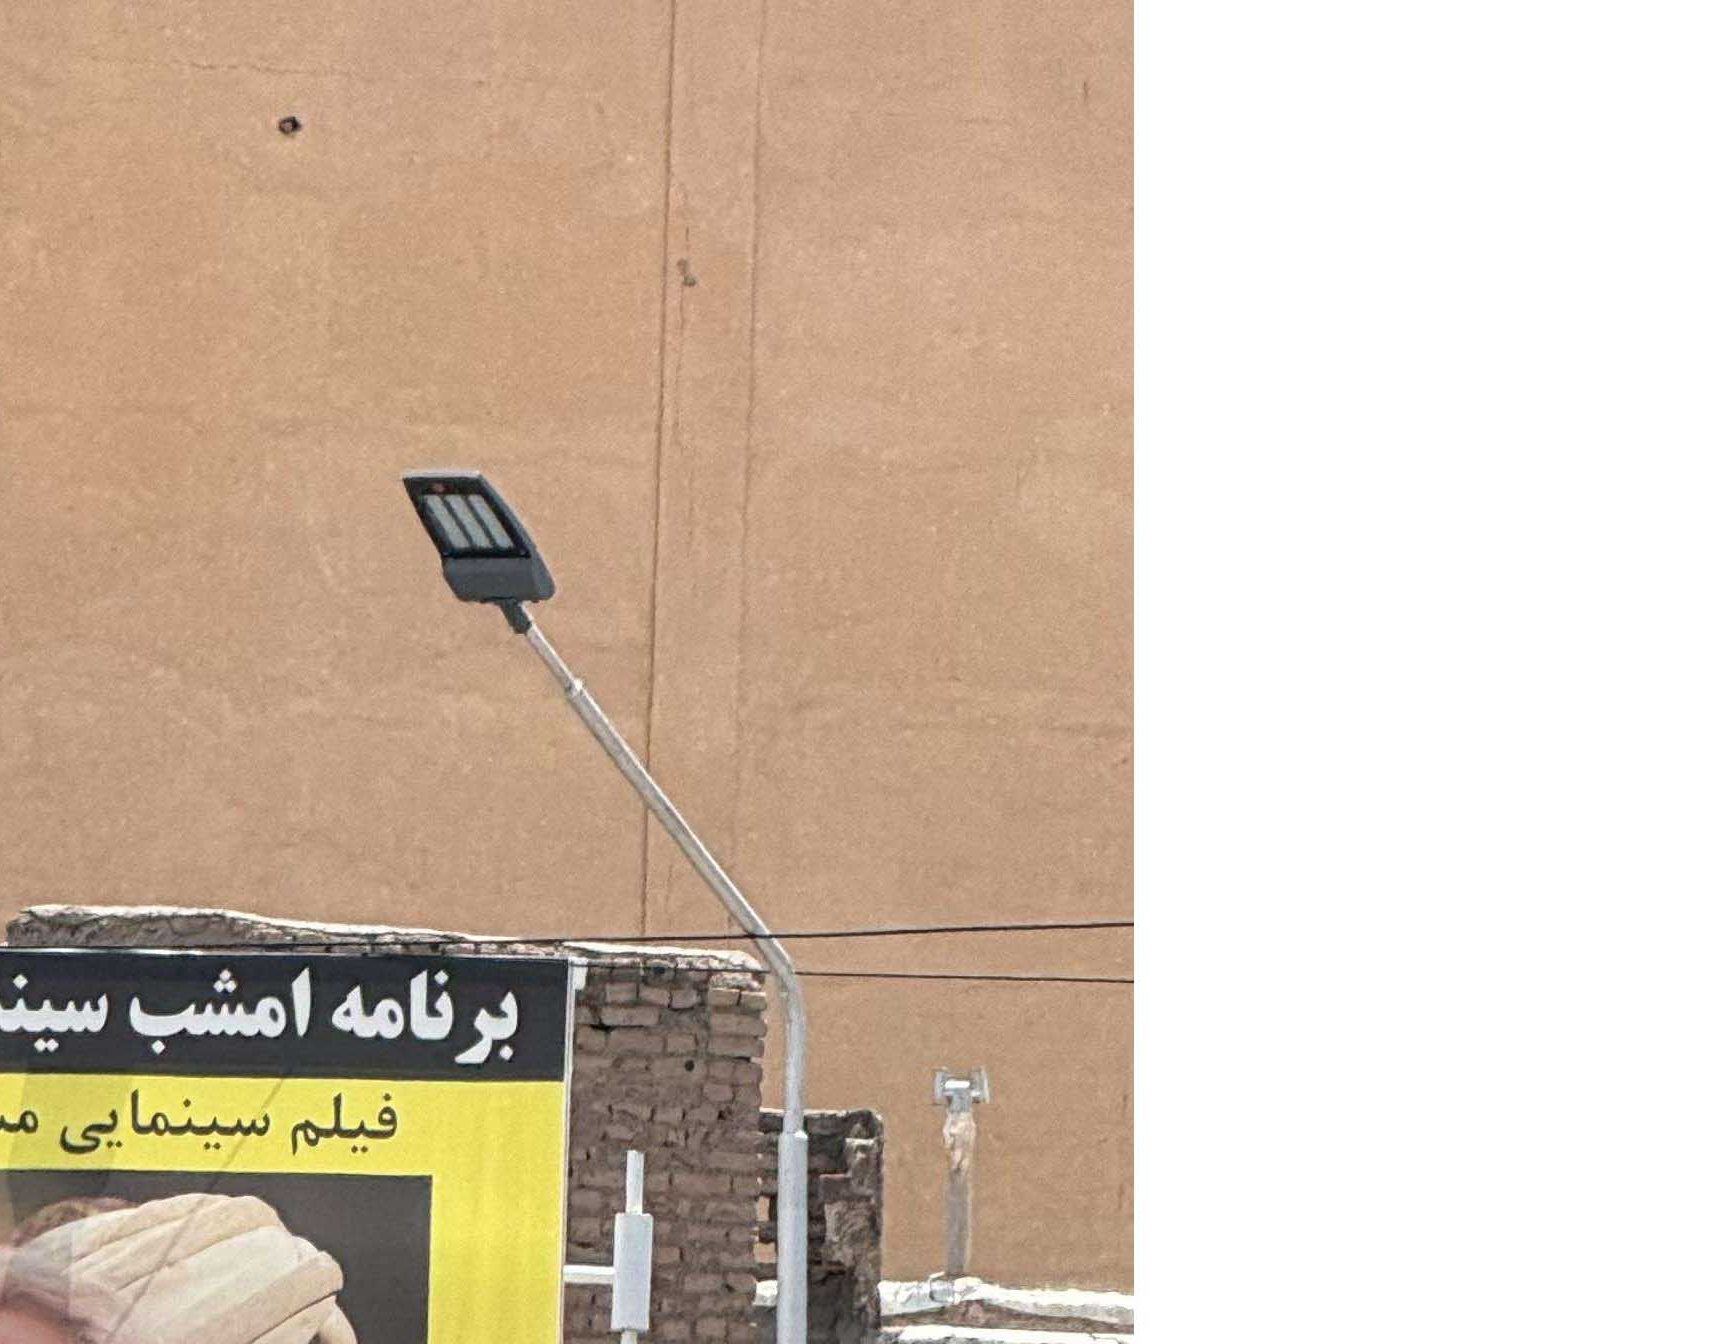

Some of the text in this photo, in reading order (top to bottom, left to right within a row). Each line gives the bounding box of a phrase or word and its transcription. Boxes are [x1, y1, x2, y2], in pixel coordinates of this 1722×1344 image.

[131, 967, 310, 1056] امشب
[330, 967, 521, 1065] برنامه
[60, 1088, 271, 1155] سینمایی
[289, 1090, 401, 1155] فیلم
